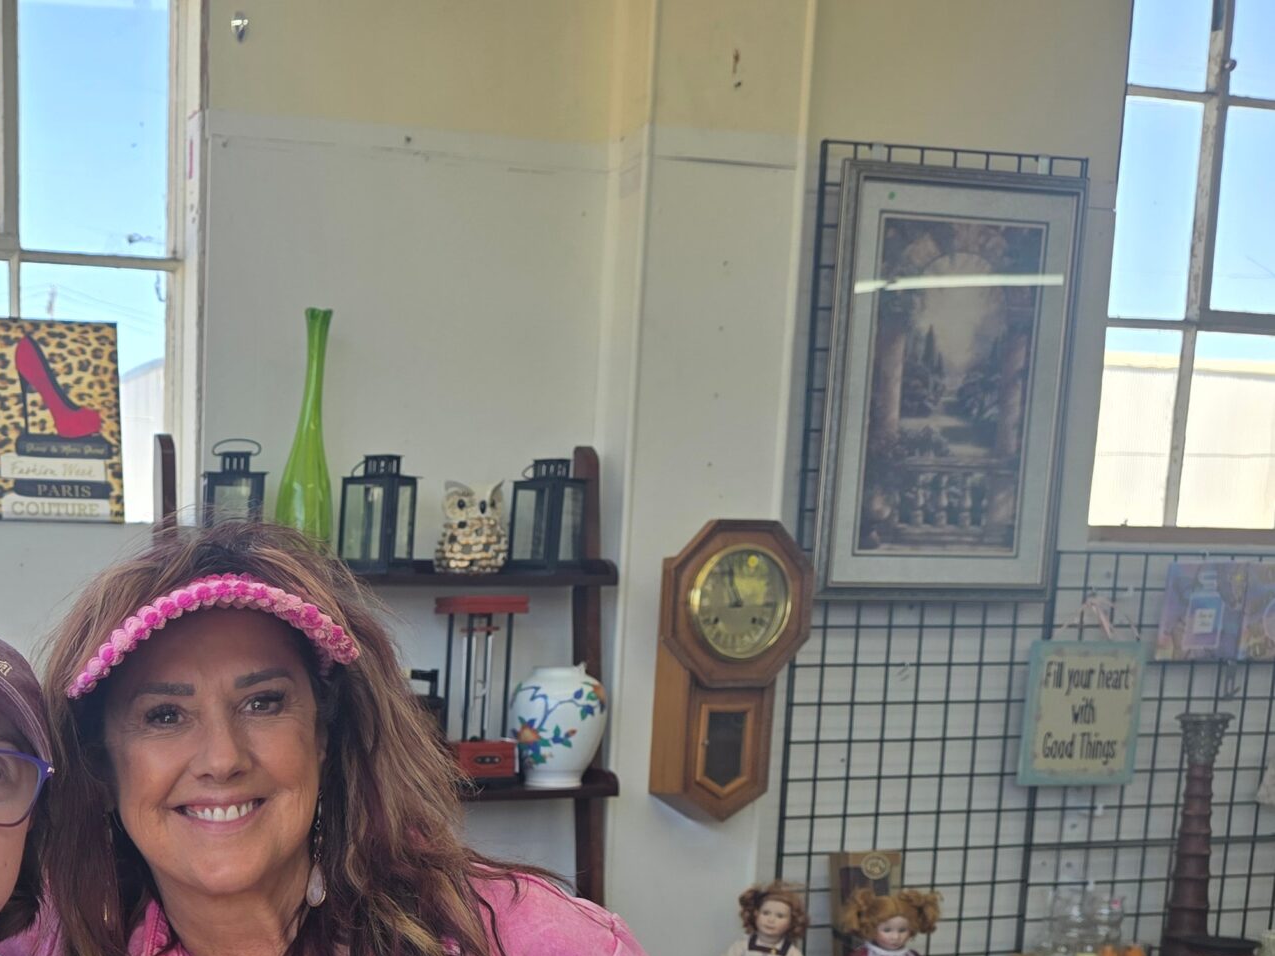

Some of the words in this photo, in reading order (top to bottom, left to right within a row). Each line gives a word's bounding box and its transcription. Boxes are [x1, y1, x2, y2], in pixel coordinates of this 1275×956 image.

[37, 484, 92, 497] PARIS
[11, 501, 100, 517] COUTURE
[1043, 661, 1063, 689] Fill
[1065, 668, 1094, 696] your
[1097, 663, 1130, 690] heart
[1071, 697, 1096, 725] with
[1042, 731, 1076, 759] Good
[1079, 732, 1116, 765] Things
